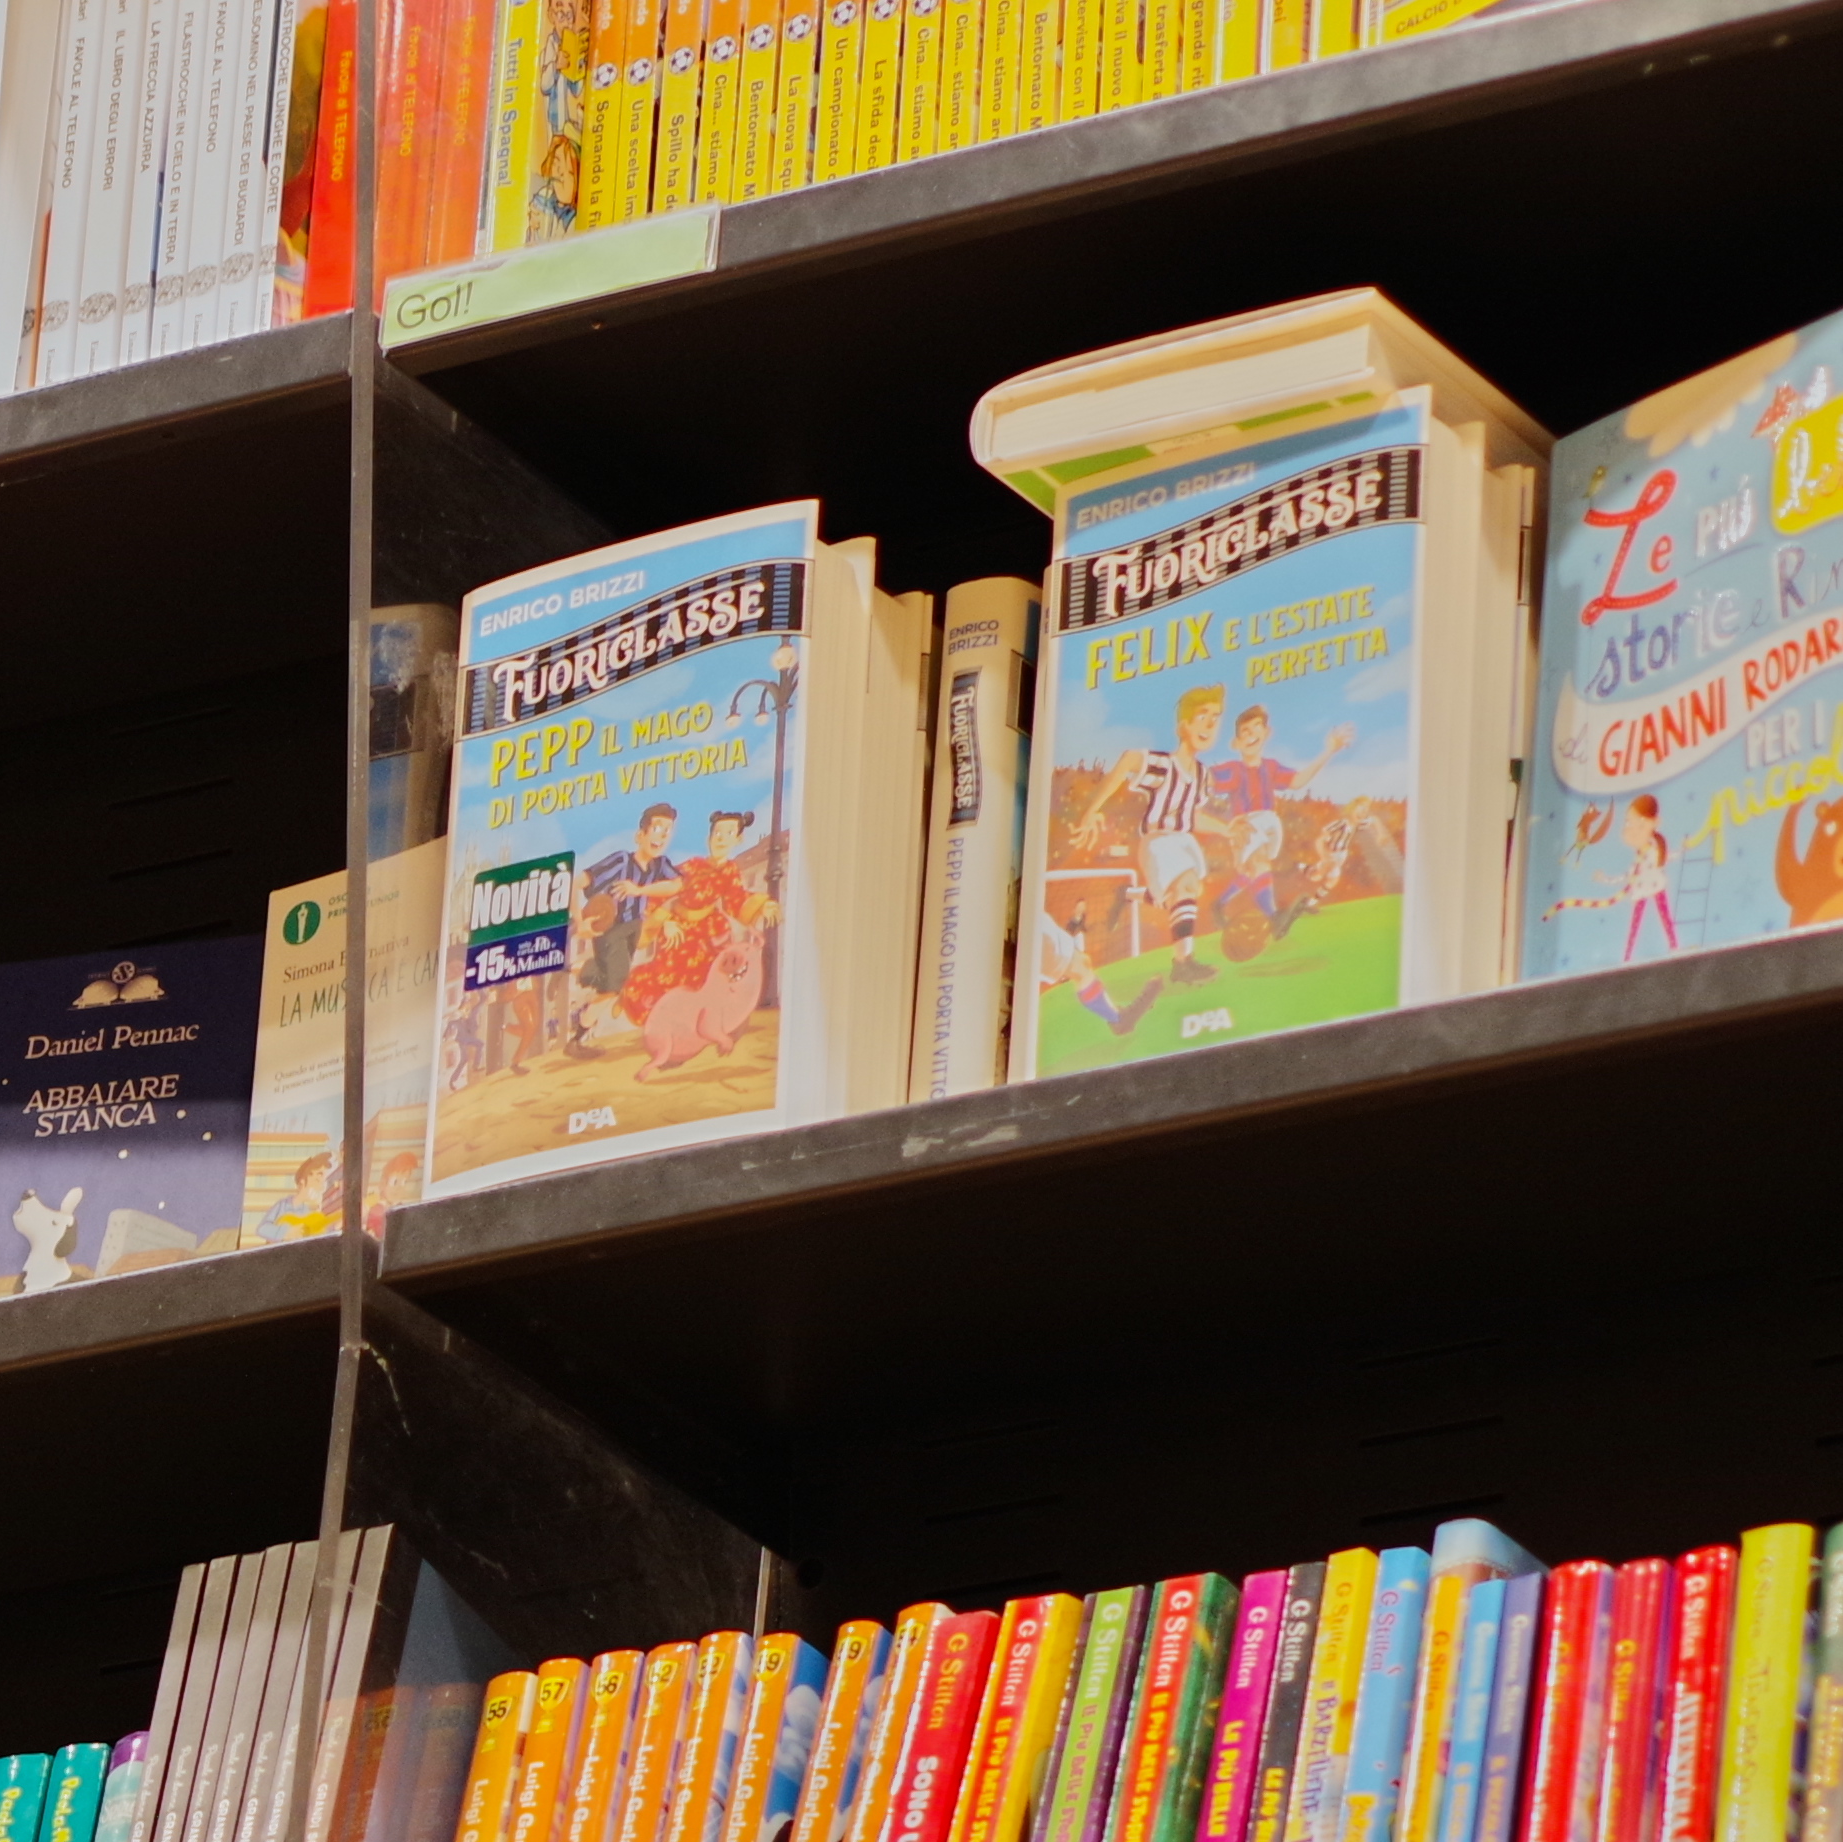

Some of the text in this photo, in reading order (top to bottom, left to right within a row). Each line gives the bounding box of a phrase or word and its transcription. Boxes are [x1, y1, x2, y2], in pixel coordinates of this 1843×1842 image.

[61, 37, 84, 188] FAVOLE AL TELEFONO
[496, 38, 523, 187] Tutti in Spagna!
[397, 281, 473, 329] Gol!
[1076, 461, 1256, 528] ENRICO BRIZZI
[1092, 471, 1383, 617] FUORICLASSE
[1581, 470, 1679, 626] Le
[480, 571, 645, 637] ENRICO BRIZZI
[1086, 585, 1377, 690] FELIX E L'ESTATE
[492, 580, 766, 720] FUORICLASSE
[1245, 626, 1388, 689] PERFETTA
[1584, 588, 1740, 698] storie
[490, 701, 713, 788] PEPP IL MAGO
[1598, 677, 1727, 777] GIANNI
[489, 739, 748, 829] DI PORTA VITTORIA
[471, 865, 571, 929] Novità
[465, 946, 516, 986] -15%
[25, 1021, 199, 1061] Daniel Pennac
[23, 1075, 180, 1115] ABBAIARE
[34, 1100, 156, 1137] STANCA
[460, 1778, 488, 1821] Luigi
[904, 1756, 939, 1821] SONO
